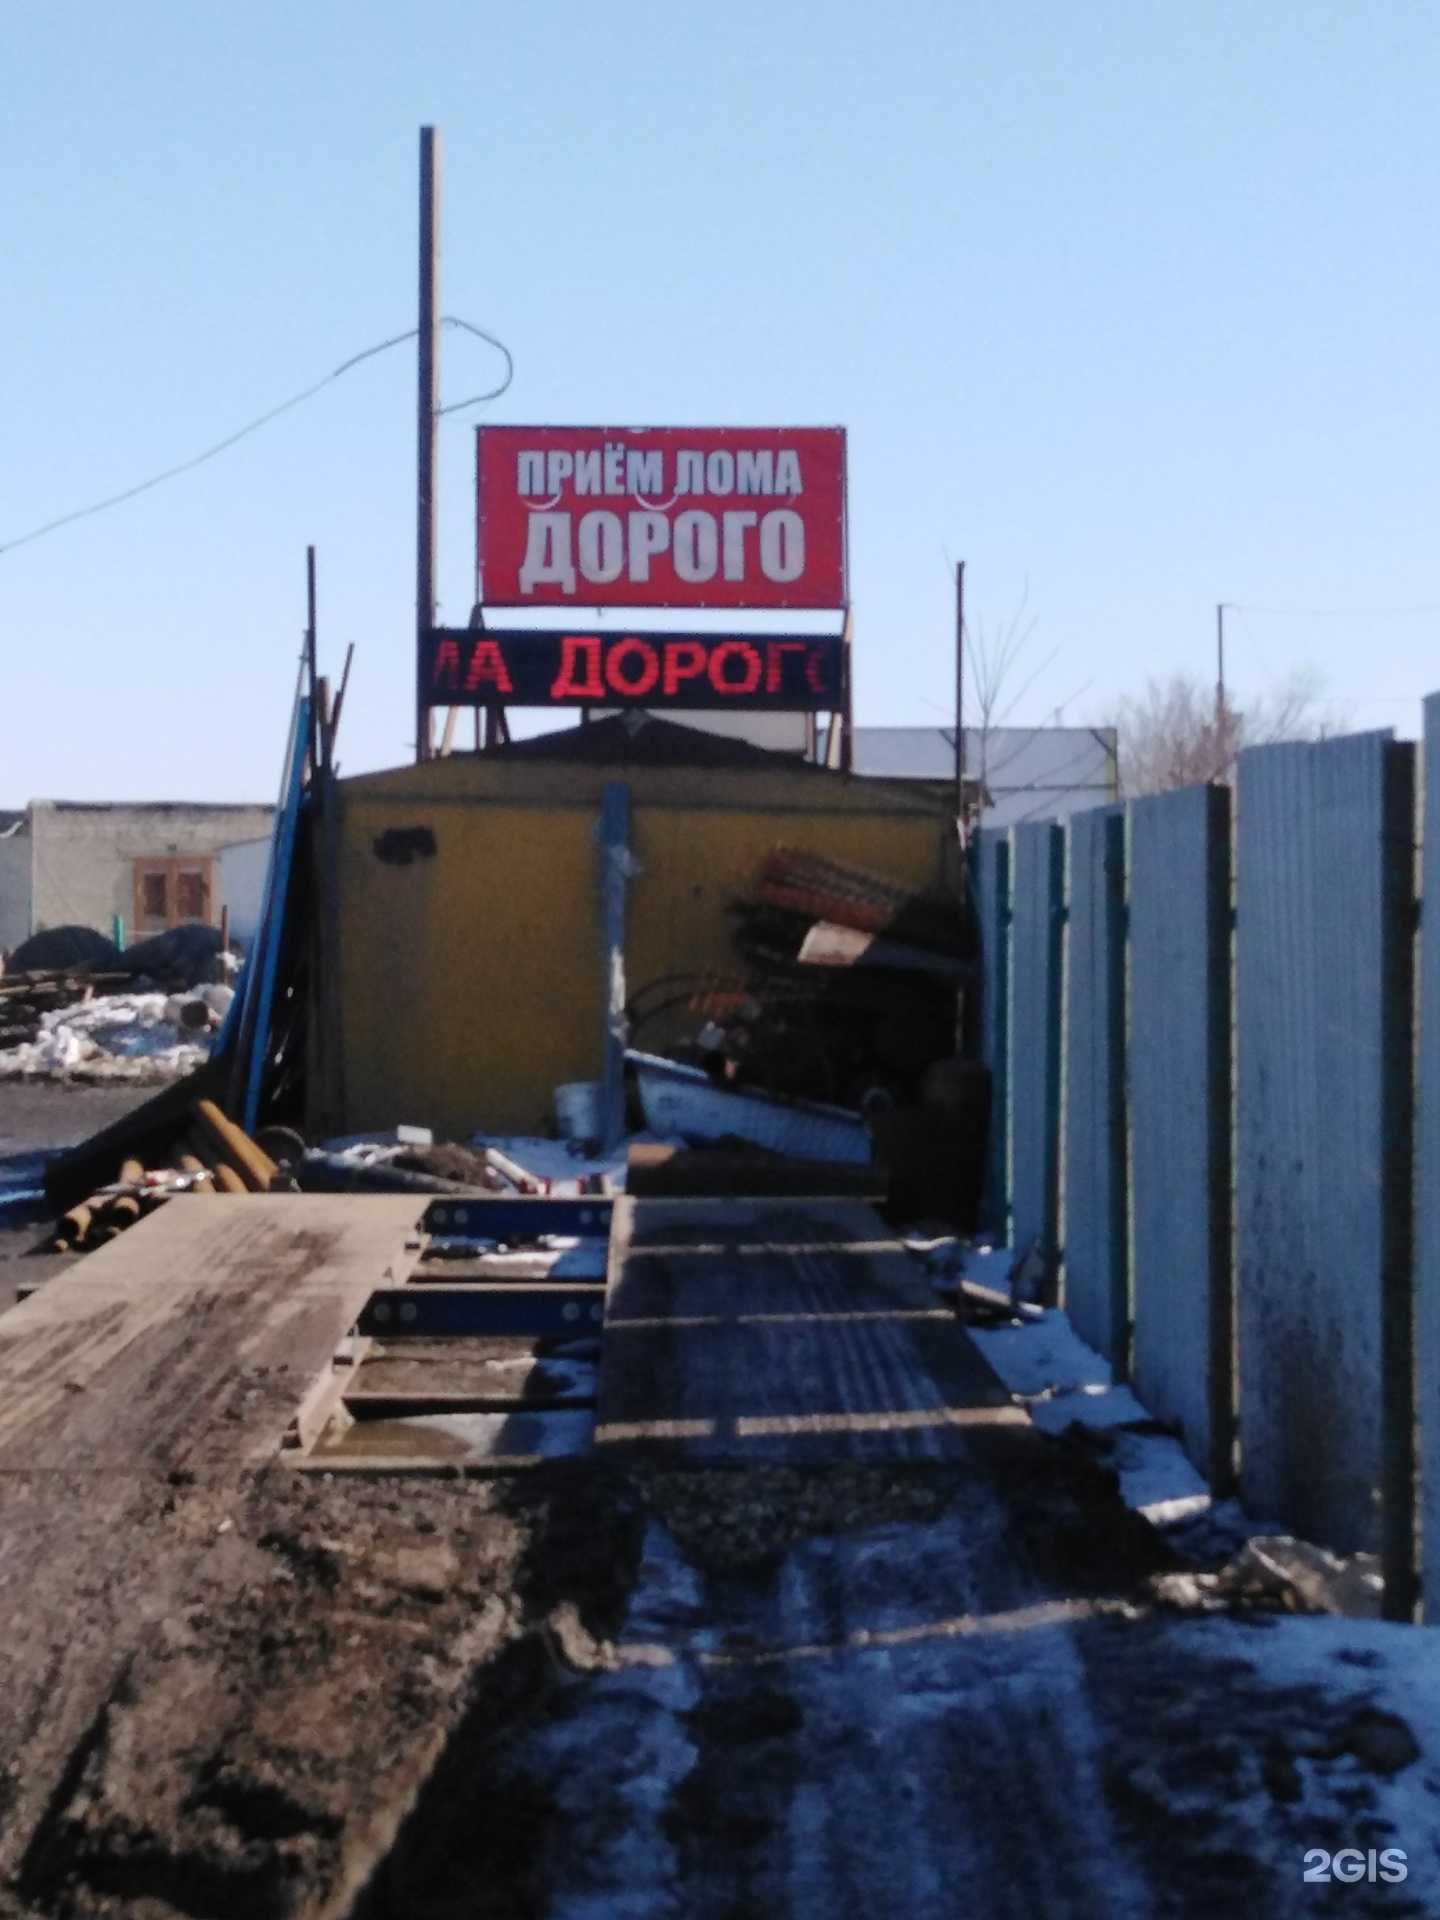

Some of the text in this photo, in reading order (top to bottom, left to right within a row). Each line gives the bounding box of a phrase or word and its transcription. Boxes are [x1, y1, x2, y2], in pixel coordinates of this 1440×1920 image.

[517, 442, 804, 496] ПРИЁМ ЛОМА
[518, 509, 806, 595] ДОРОГО
